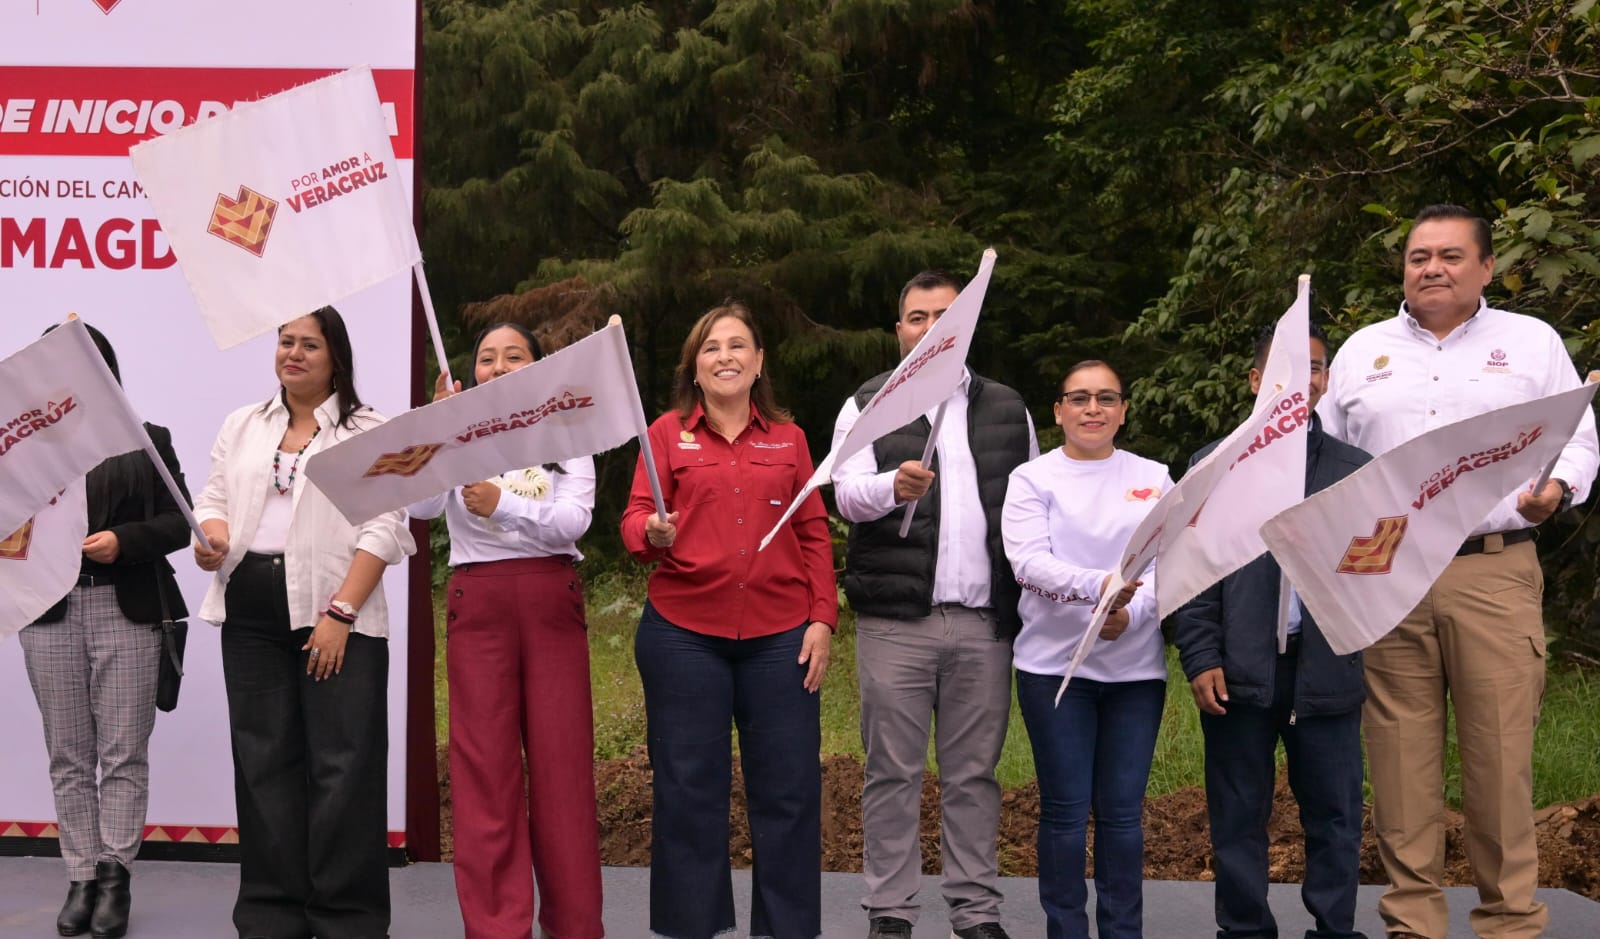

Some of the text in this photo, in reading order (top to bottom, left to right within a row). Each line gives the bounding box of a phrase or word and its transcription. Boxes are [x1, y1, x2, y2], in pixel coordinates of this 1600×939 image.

[0, 99, 36, 132] E
[40, 99, 185, 134] INICIO
[57, 180, 97, 198] DEL
[285, 161, 388, 214] VERACRUZ
[291, 152, 372, 191] POR AMOR A
[1, 217, 178, 270] MAGD
[47, 400, 57, 411] A
[456, 396, 595, 443] VERACRUZ
[467, 417, 502, 431] POR
[509, 396, 557, 420] AMOR
[0, 396, 77, 456] ACRUZ
[1411, 425, 1542, 510] VERACRUZ
[1457, 442, 1512, 464] AMOR
